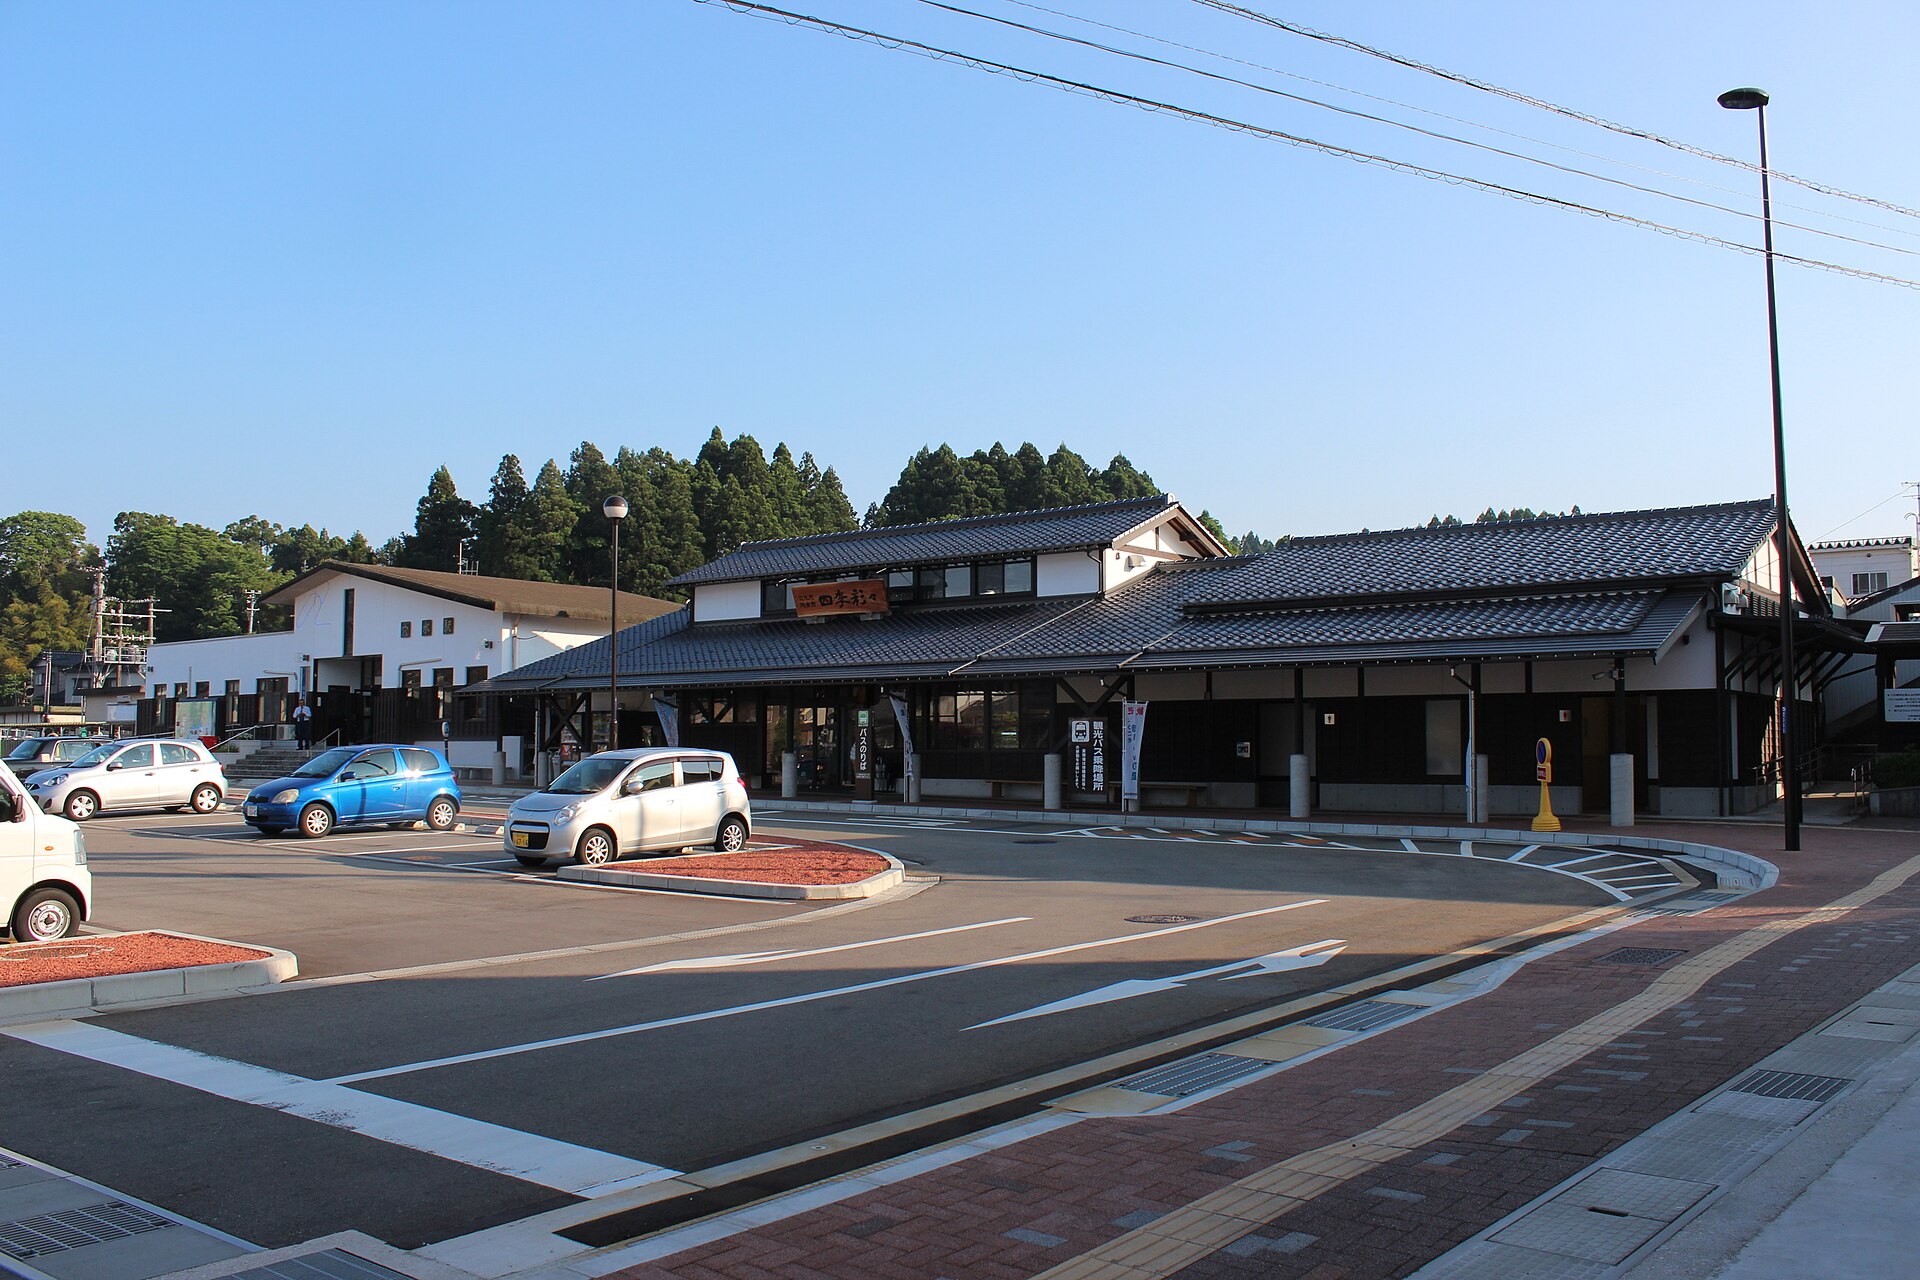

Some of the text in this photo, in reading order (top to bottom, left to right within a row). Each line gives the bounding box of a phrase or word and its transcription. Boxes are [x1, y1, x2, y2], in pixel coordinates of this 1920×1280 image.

[819, 588, 877, 608] 四季彩々
[1093, 721, 1104, 791] 観光バス乗降場所
